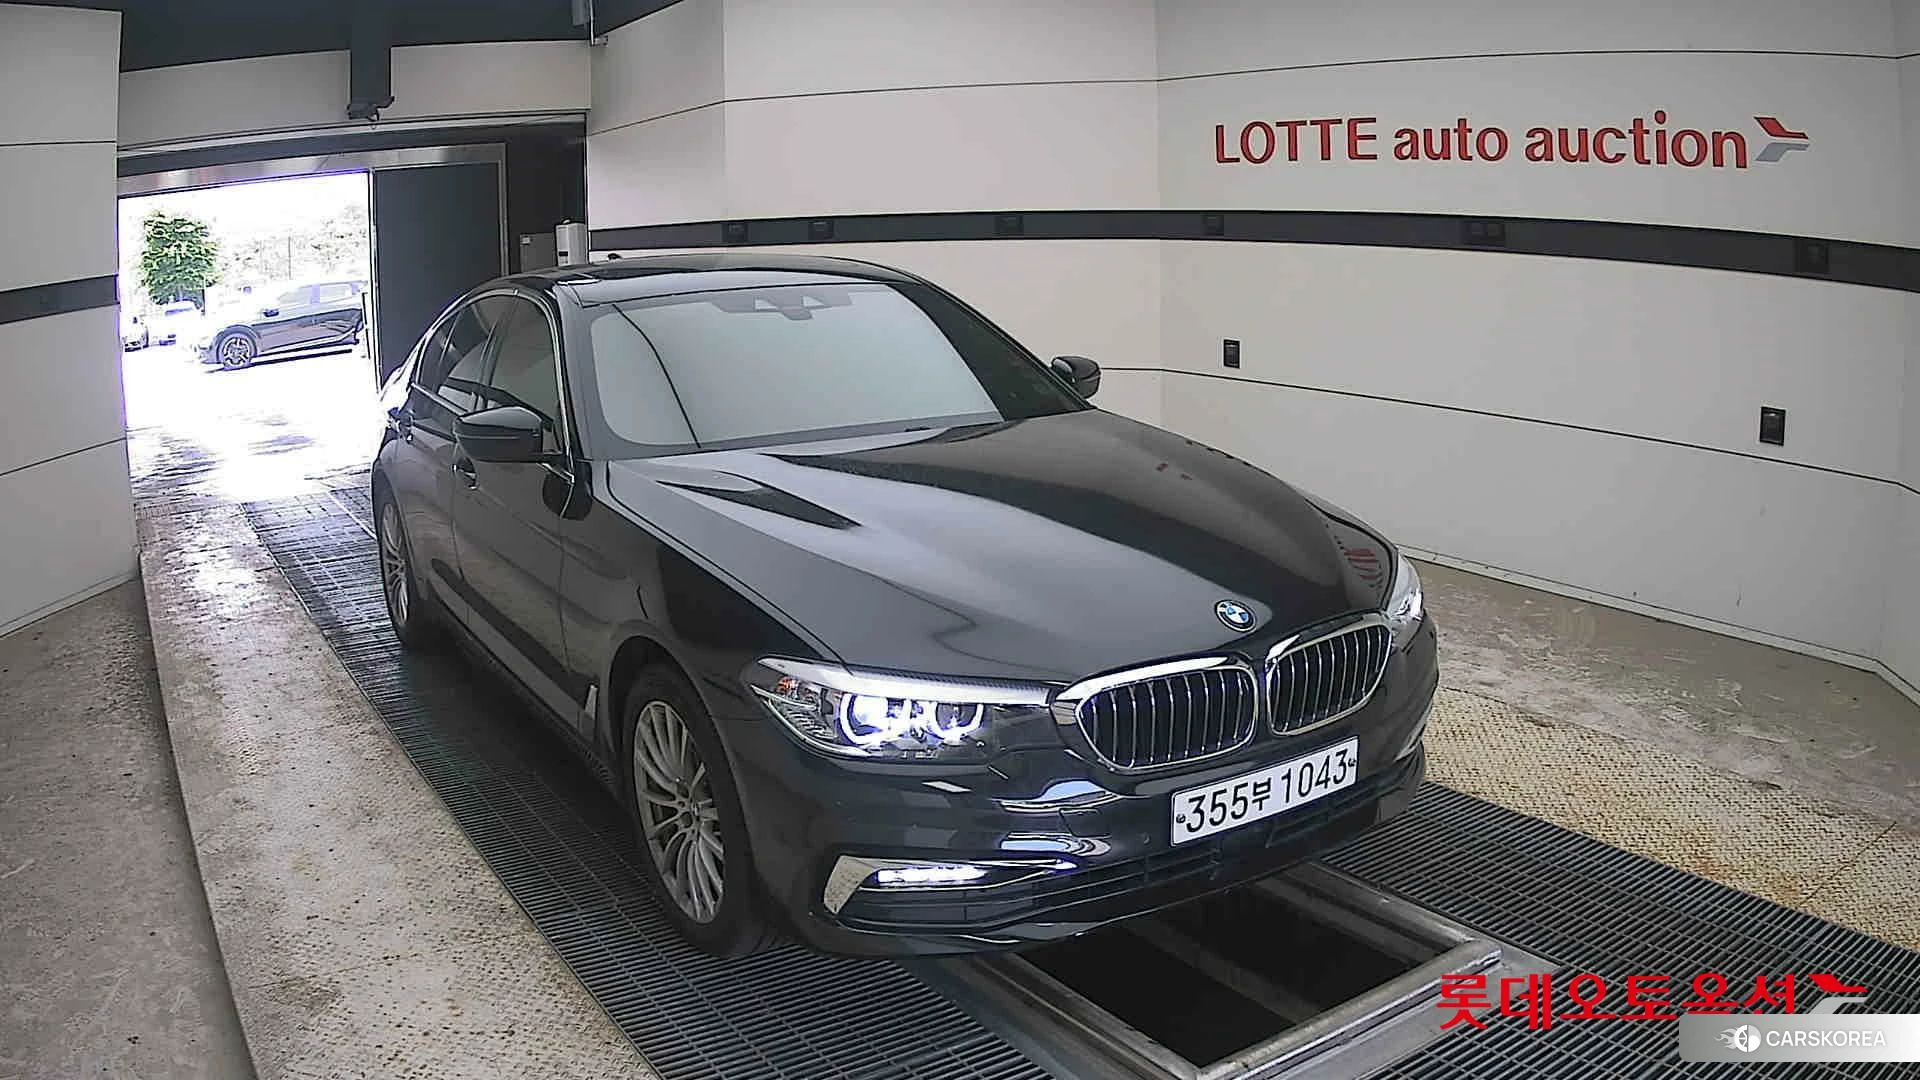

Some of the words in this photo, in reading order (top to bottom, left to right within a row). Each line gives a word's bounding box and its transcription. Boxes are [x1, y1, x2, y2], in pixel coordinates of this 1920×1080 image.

[1214, 116, 1379, 164] LOTTE
[1392, 117, 1509, 162] auto
[1524, 110, 1749, 169] auction
[1186, 777, 1271, 833] 355부
[1281, 748, 1349, 803] 1043
